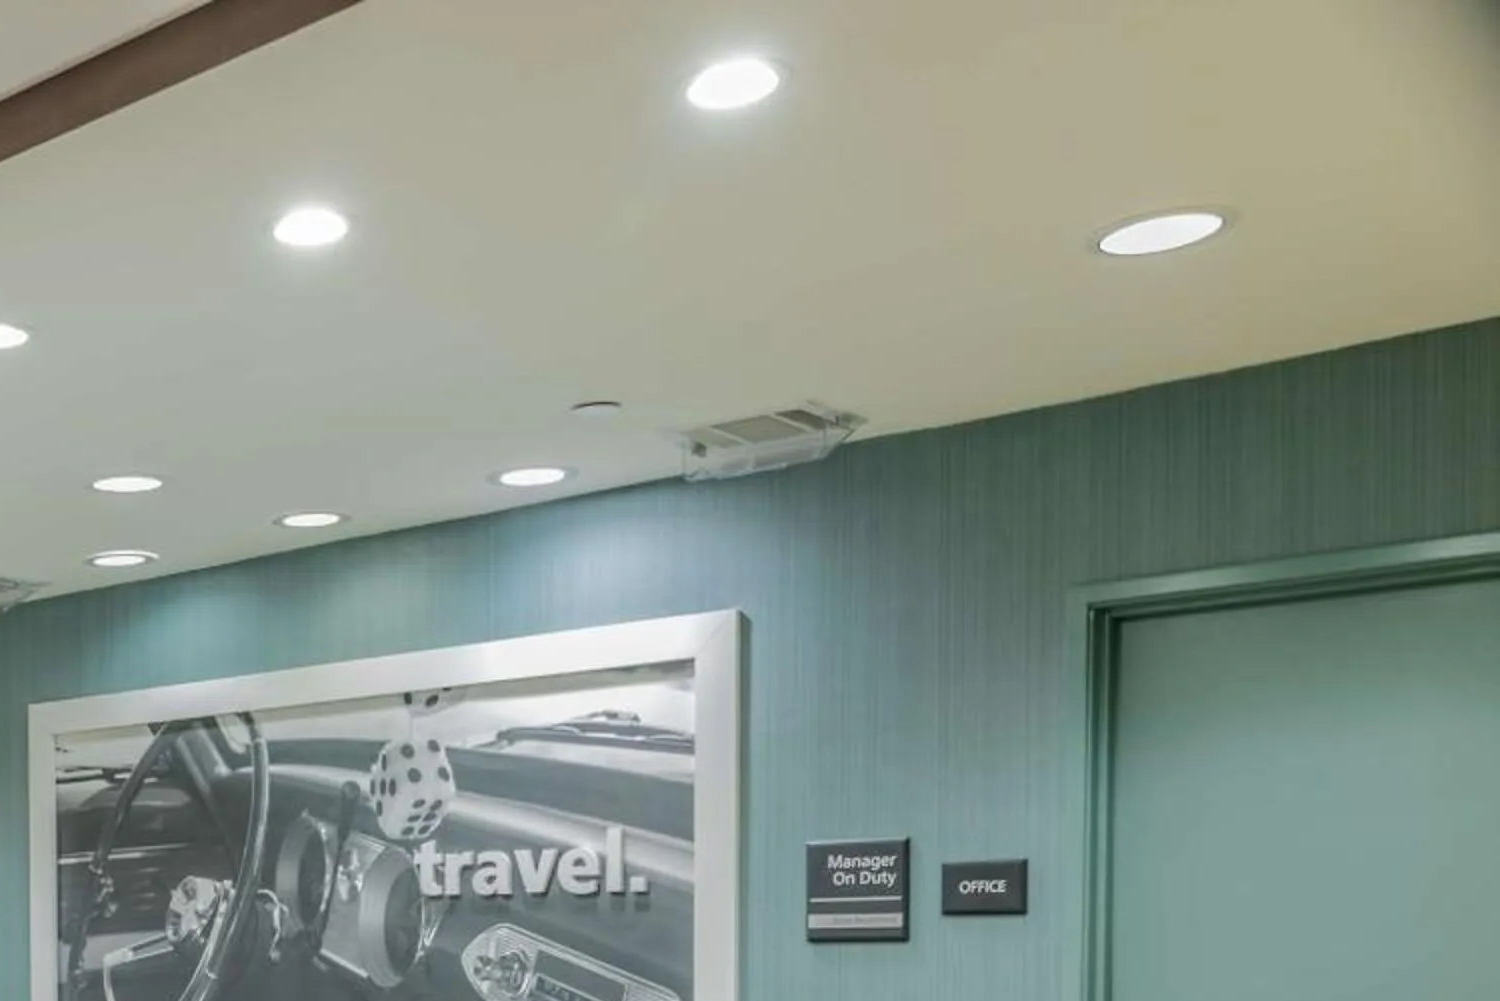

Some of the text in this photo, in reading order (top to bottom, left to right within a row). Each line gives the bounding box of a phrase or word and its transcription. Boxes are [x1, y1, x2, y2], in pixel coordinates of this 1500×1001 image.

[414, 827, 647, 896] travel.
[827, 854, 897, 871] Manager
[833, 871, 896, 888] On Duty
[959, 879, 1007, 894] OFFICE
